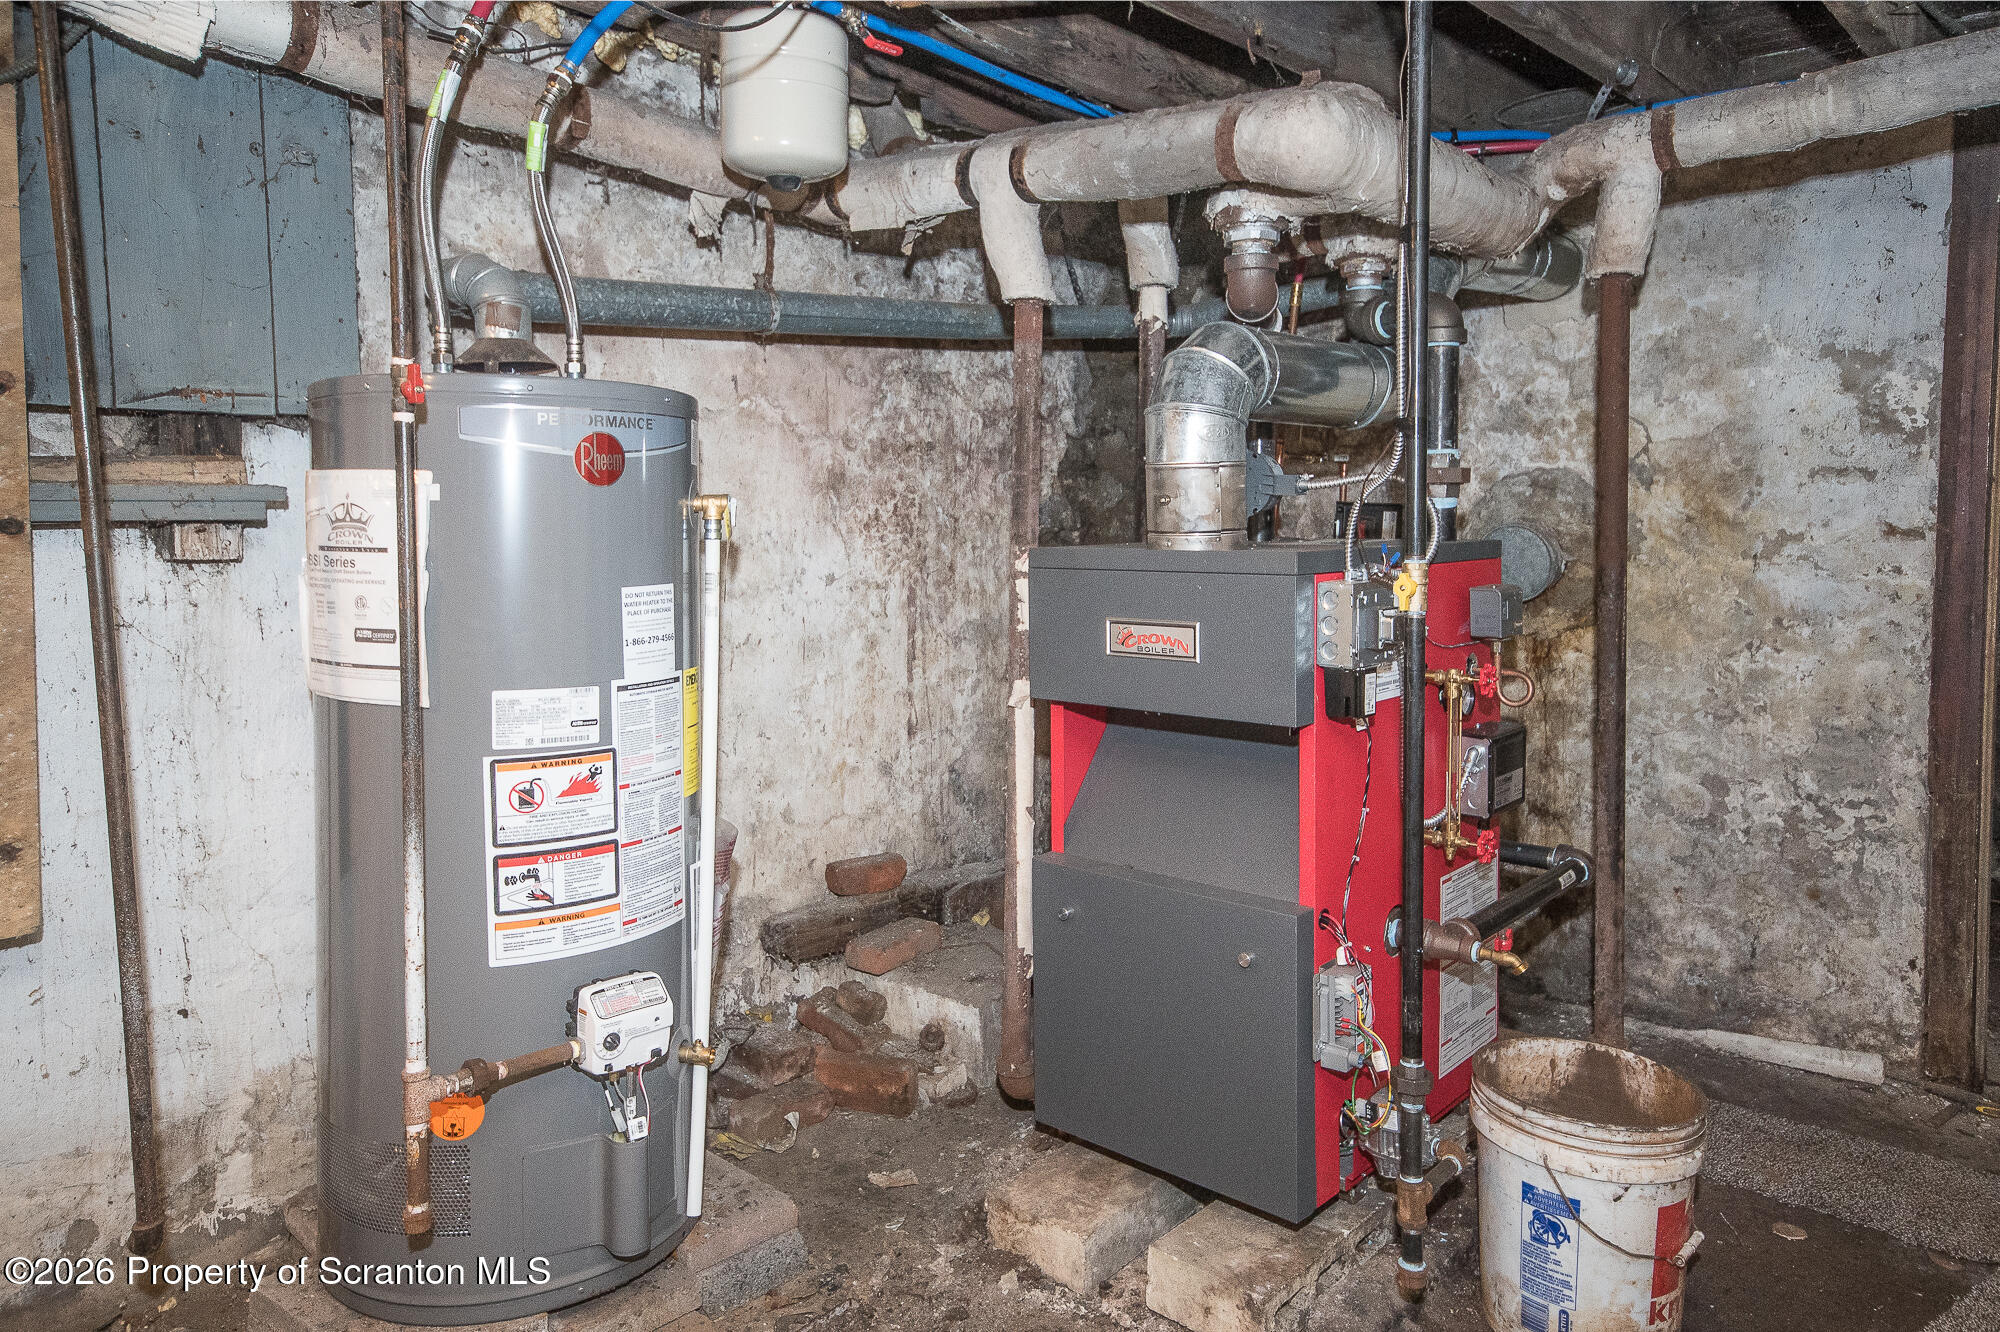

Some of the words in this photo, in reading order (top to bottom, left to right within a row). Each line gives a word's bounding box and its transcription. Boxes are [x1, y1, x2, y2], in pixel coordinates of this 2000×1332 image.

[537, 412, 654, 430] PEORMANCE
[580, 433, 623, 478] Rheem
[328, 530, 374, 544] CROWN
[323, 554, 356, 568] Series
[625, 632, 675, 647] 1-866-279-4566
[1124, 633, 1189, 655] CROWN
[1137, 645, 1175, 655] BOILER
[541, 758, 583, 768] WARNING
[547, 851, 583, 863] DANGER
[549, 912, 585, 924] WARNING
